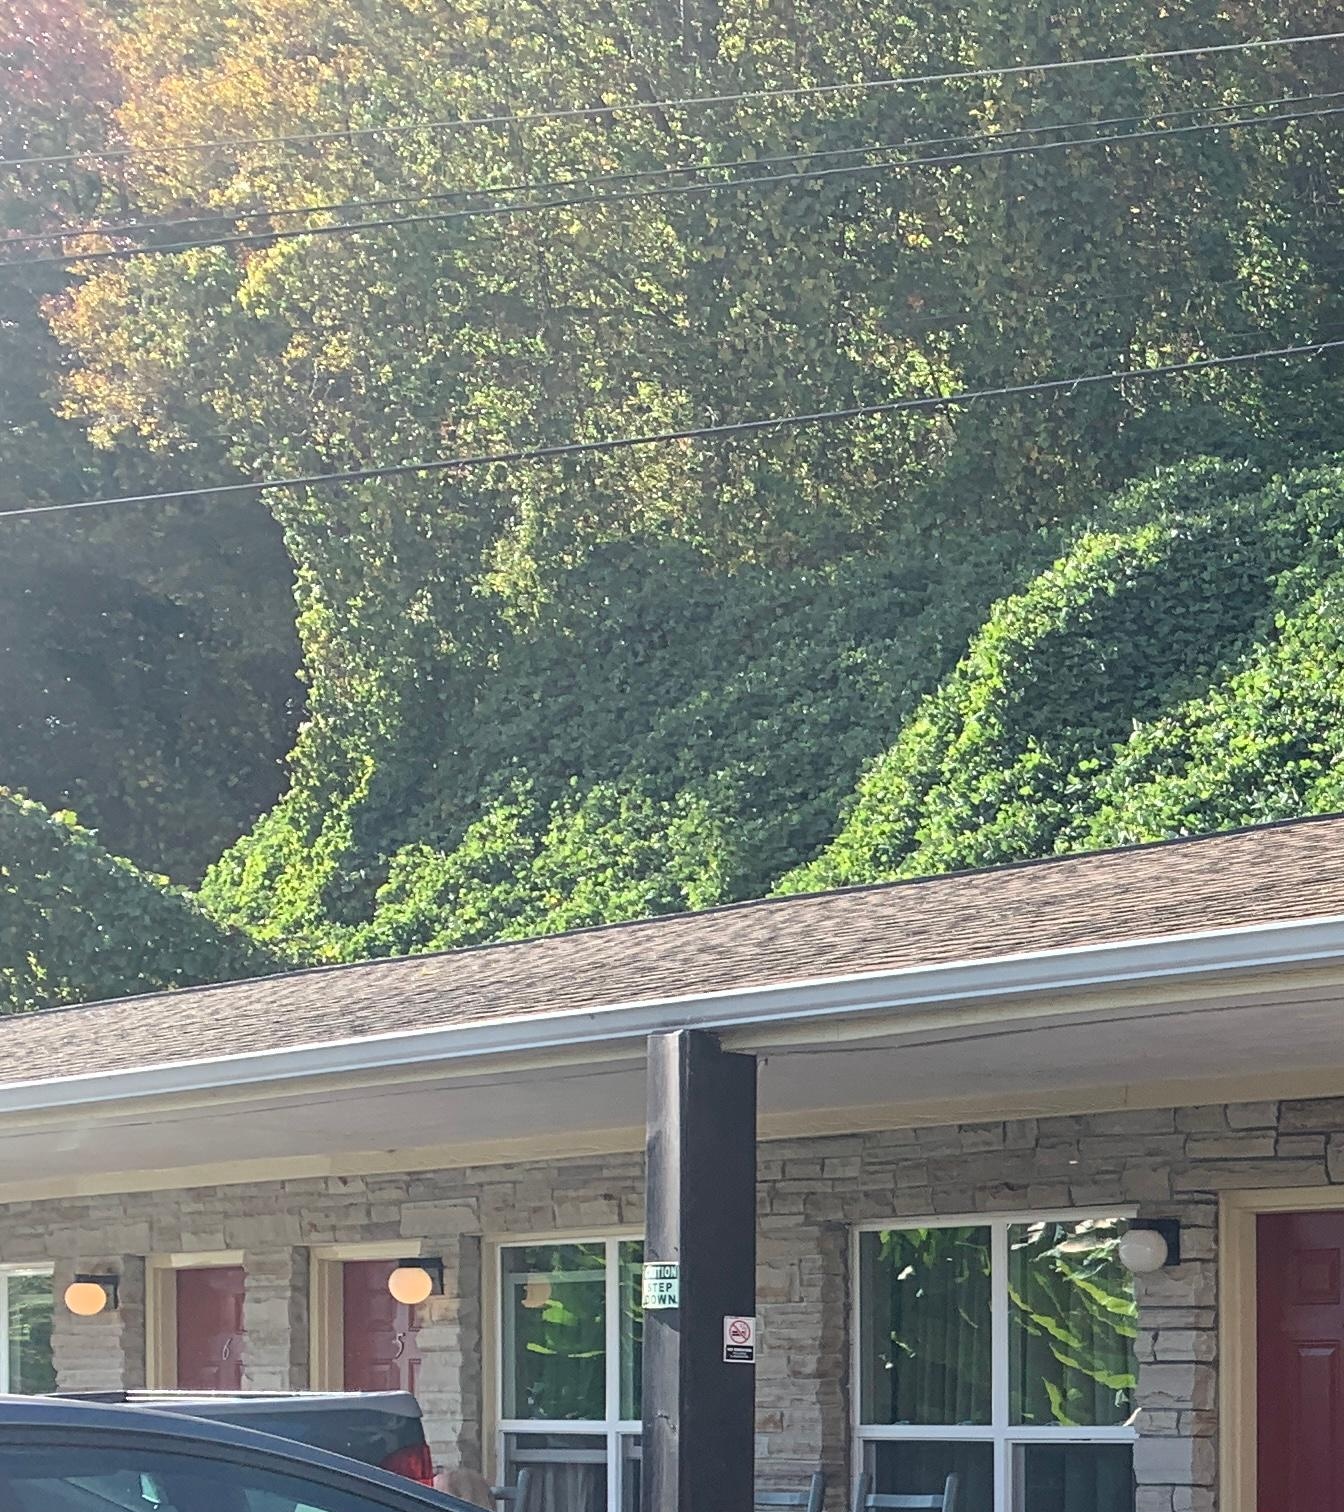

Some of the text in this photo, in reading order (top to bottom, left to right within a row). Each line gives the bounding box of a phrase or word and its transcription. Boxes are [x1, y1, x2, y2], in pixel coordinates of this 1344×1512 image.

[647, 1282, 673, 1292] STEP
[644, 1294, 677, 1305] DOWN
[222, 1338, 233, 1361] 6
[391, 1332, 405, 1360] 5
